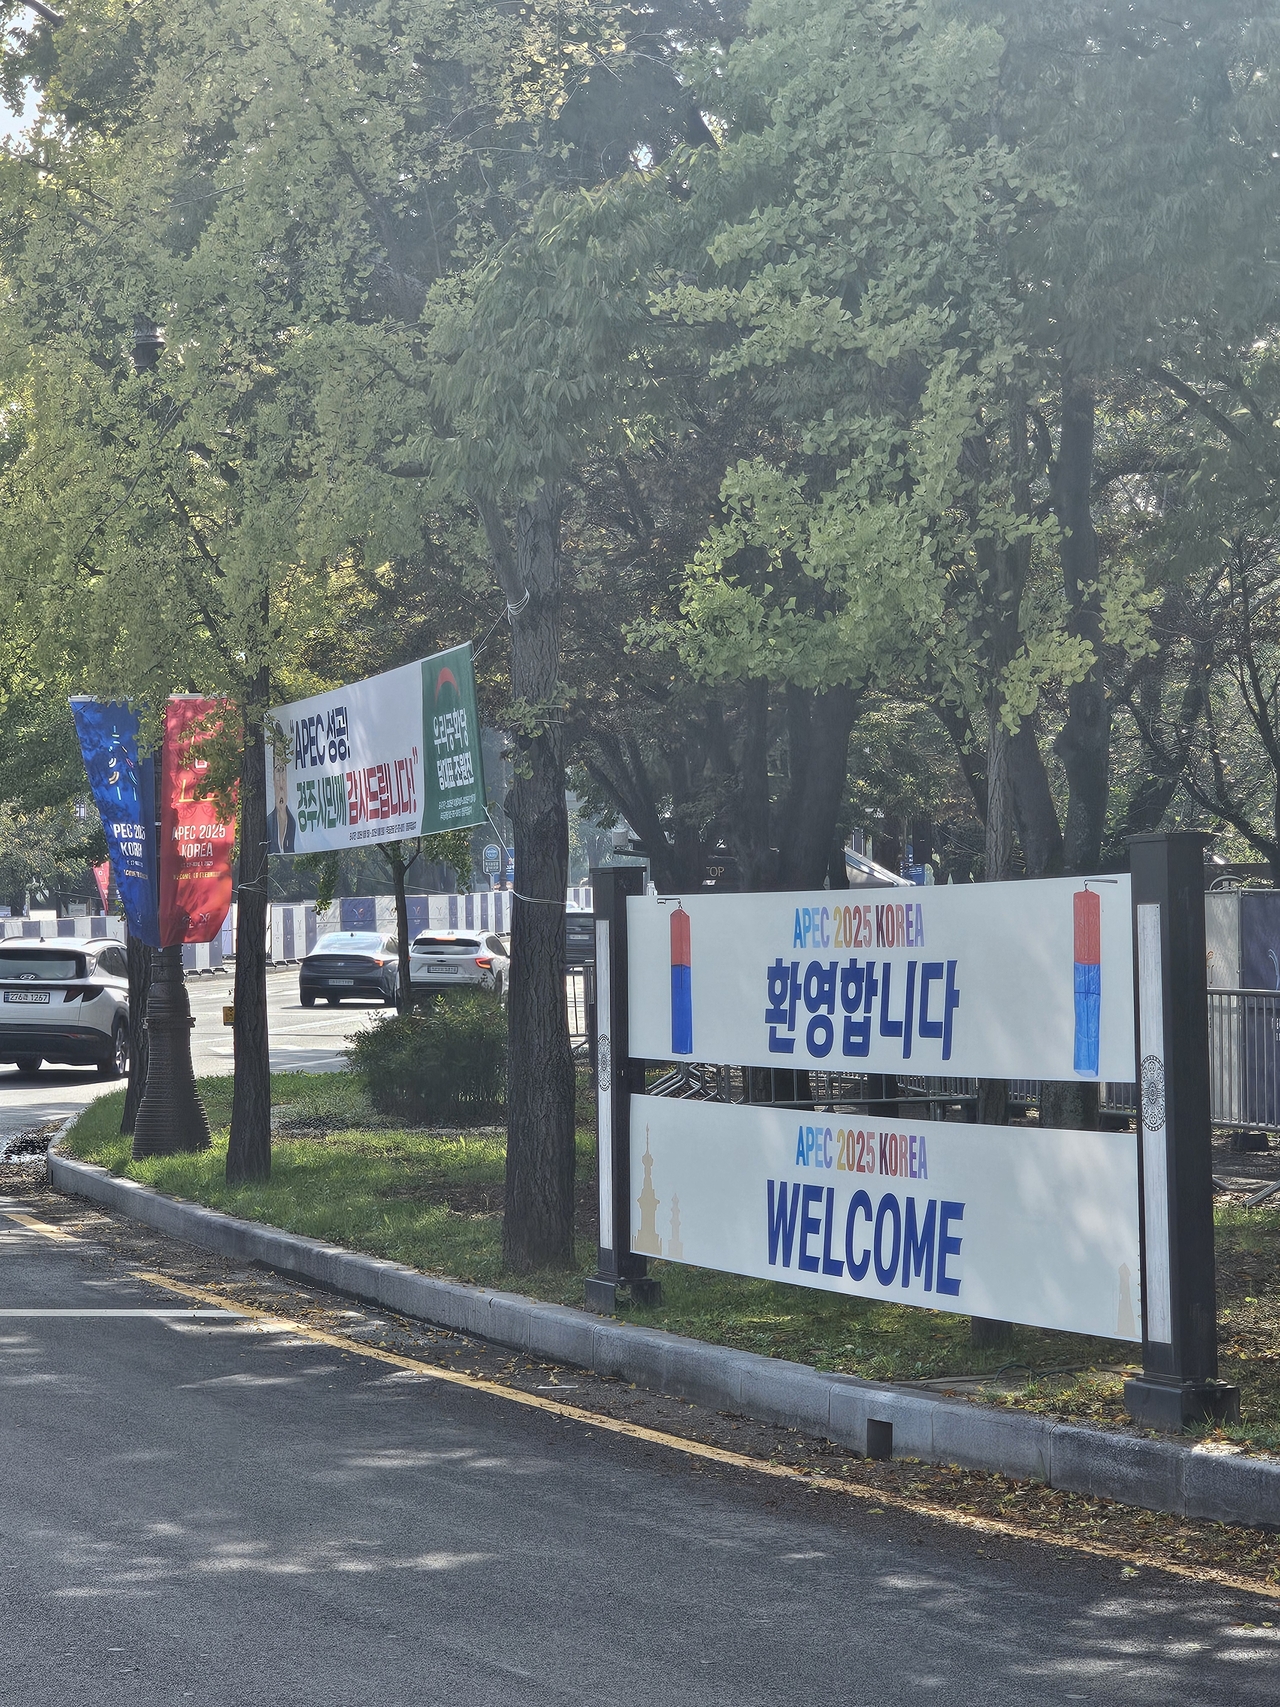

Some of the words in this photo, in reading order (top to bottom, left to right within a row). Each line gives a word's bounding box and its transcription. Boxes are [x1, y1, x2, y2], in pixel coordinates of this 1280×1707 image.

[327, 706, 351, 763] 성공!
[433, 708, 469, 754] 우리공화당
[296, 773, 347, 833] 경주시민께
[110, 823, 133, 839] PEC
[171, 825, 197, 841] APEC
[199, 823, 226, 839] 2025
[181, 842, 213, 858] KOREA
[793, 905, 830, 949] APEC
[833, 904, 873, 949] 2025
[875, 902, 925, 948] KOREA
[765, 957, 960, 1061] 환영합니다
[795, 1125, 833, 1167] APEC
[836, 1128, 876, 1174] 2025
[879, 1131, 928, 1180] KOREA
[766, 1178, 967, 1297] WELCOME
